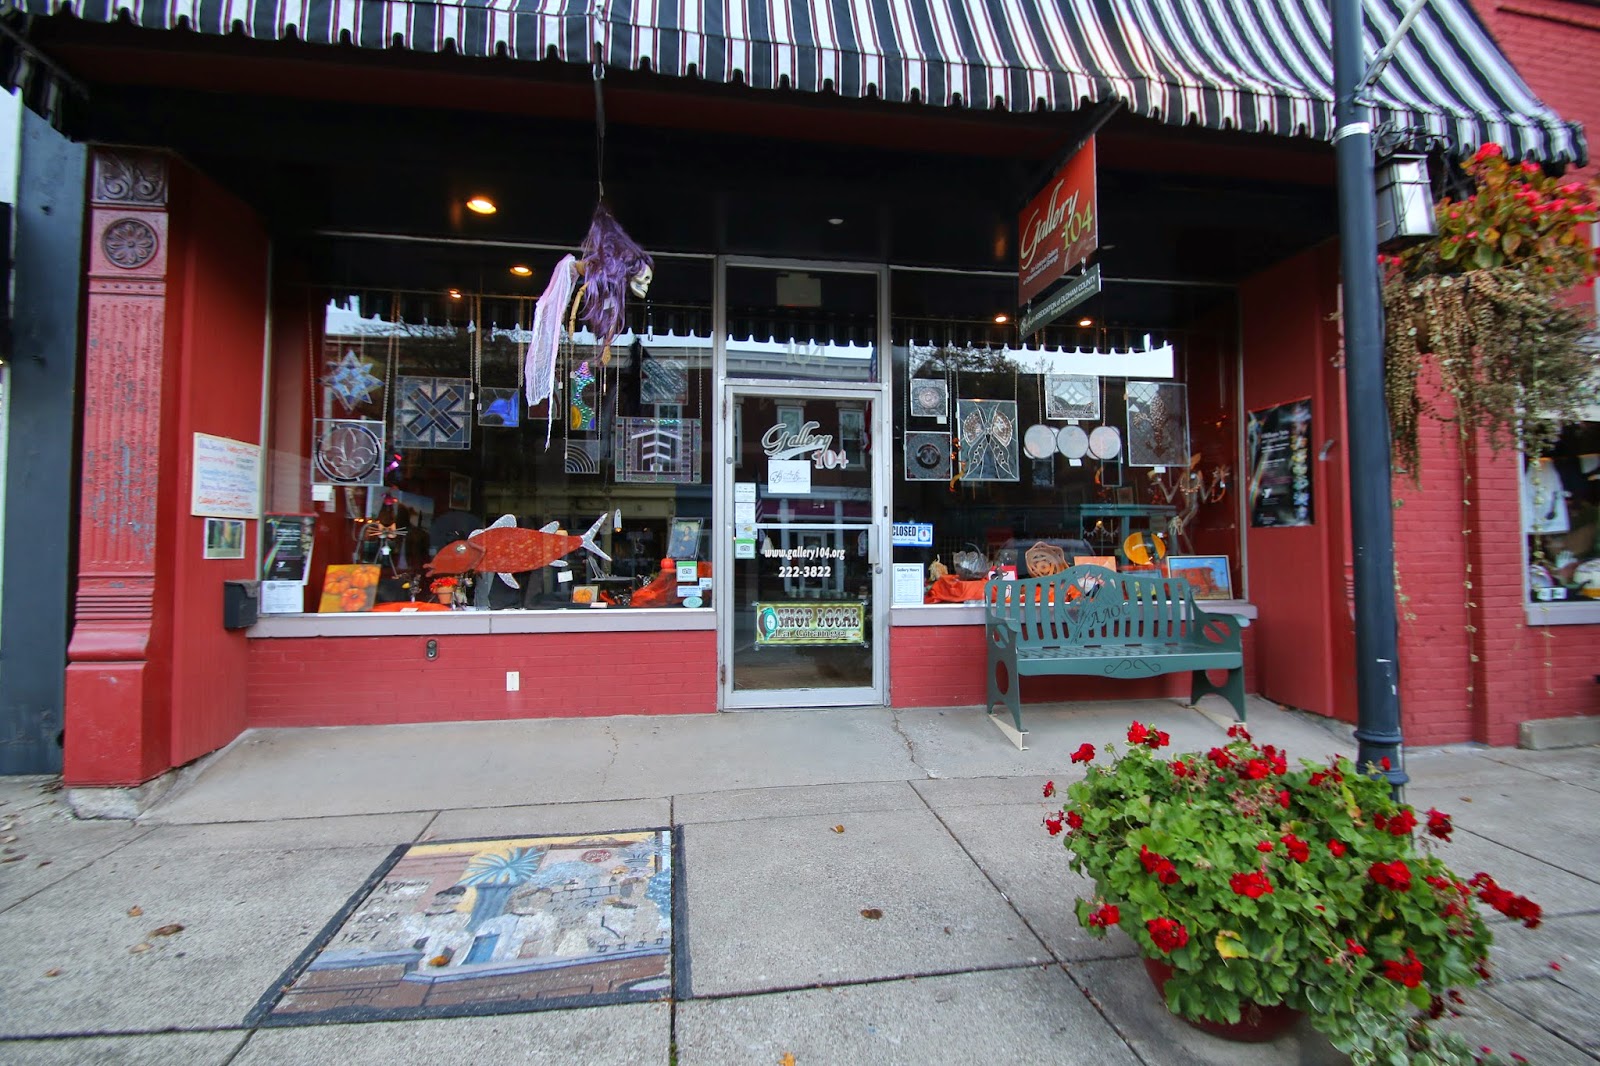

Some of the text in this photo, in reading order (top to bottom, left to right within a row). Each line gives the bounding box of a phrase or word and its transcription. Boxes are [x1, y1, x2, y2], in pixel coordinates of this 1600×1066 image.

[1021, 179, 1079, 270] Gallery
[1063, 200, 1092, 250] 104
[1060, 287, 1079, 302] OLDHAM
[1078, 275, 1096, 290] COUNTY
[761, 421, 833, 456] Gallery
[811, 449, 849, 470] 104
[892, 525, 917, 537] CLOSED
[764, 545, 846, 561] www.gallery104.org
[778, 566, 832, 578] 222-3822
[777, 607, 860, 628] SHOP LOCAL
[774, 629, 847, 640] La Grange
